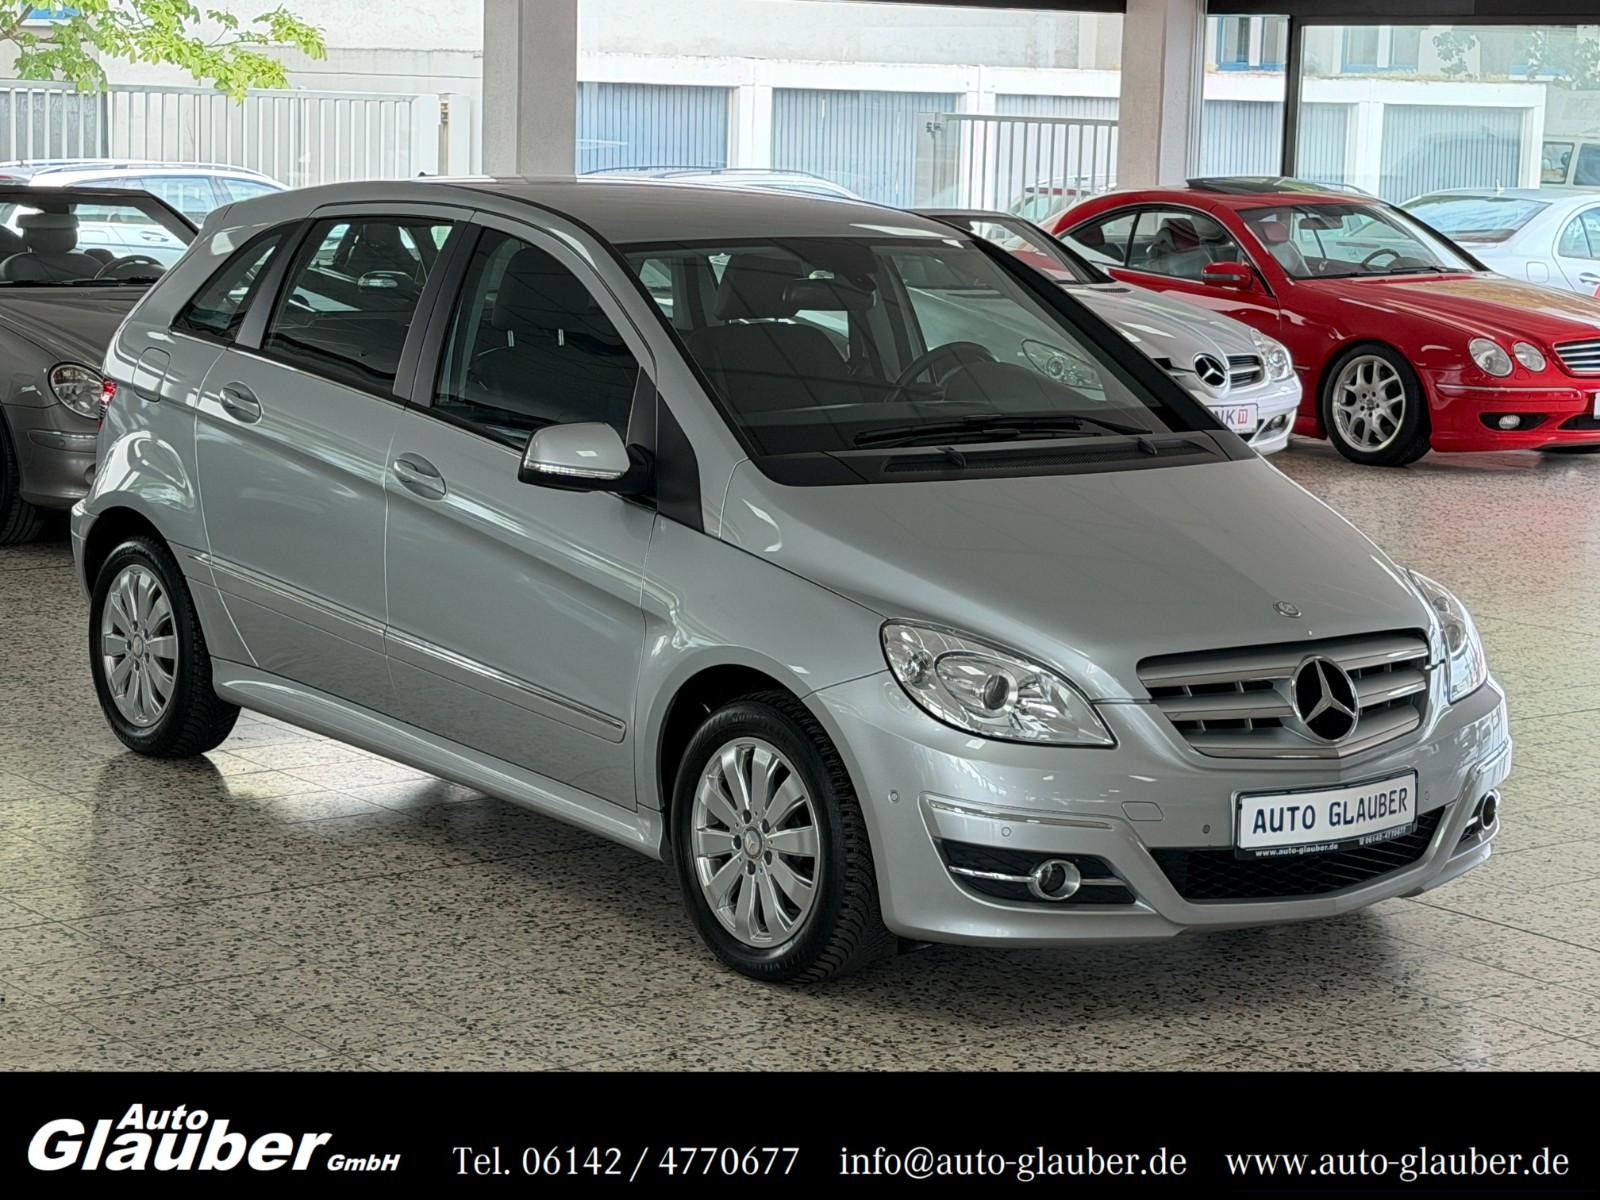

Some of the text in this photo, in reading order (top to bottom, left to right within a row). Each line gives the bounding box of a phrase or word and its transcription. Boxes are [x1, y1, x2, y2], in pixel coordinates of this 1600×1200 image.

[1253, 787, 1408, 834] AUTO GLAUBER
[1255, 842, 1339, 857] www.auto-glauber.de
